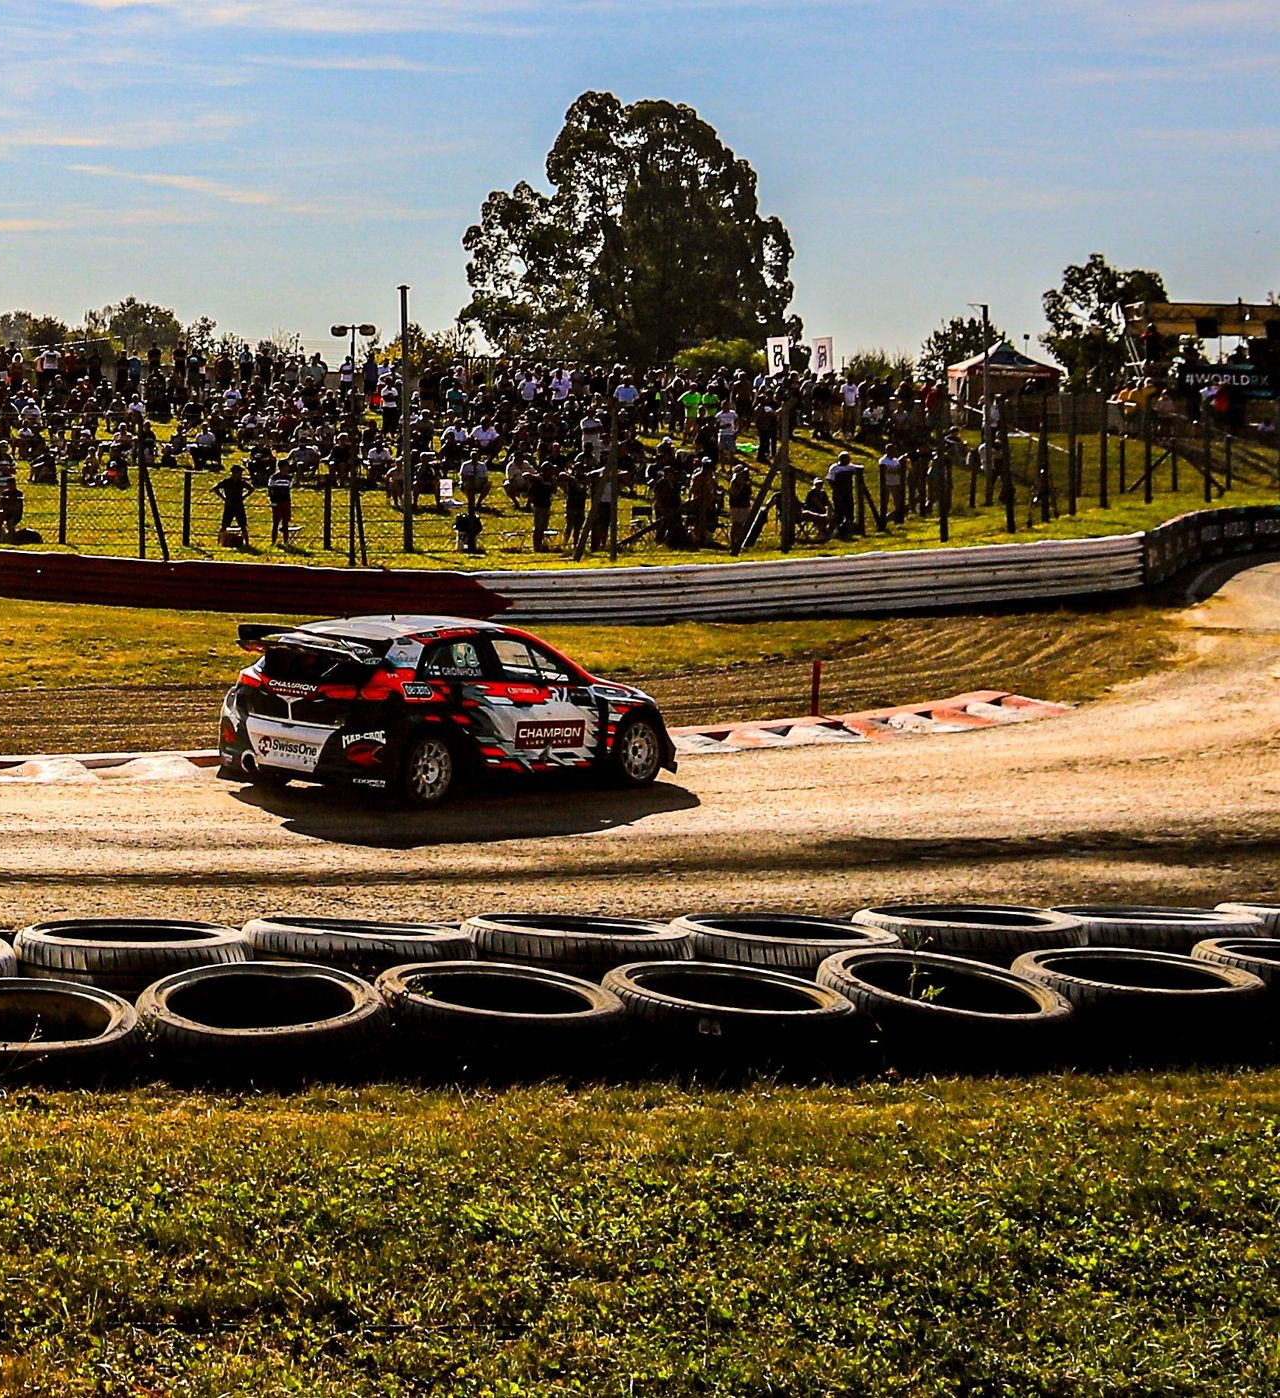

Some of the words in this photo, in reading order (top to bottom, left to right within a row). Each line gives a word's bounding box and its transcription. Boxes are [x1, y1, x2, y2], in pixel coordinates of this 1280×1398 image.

[268, 679, 318, 692] CHAMPION
[342, 731, 387, 749] MAD-CROC
[519, 727, 582, 738] CHAMPION
[272, 739, 317, 757] SwissOne
